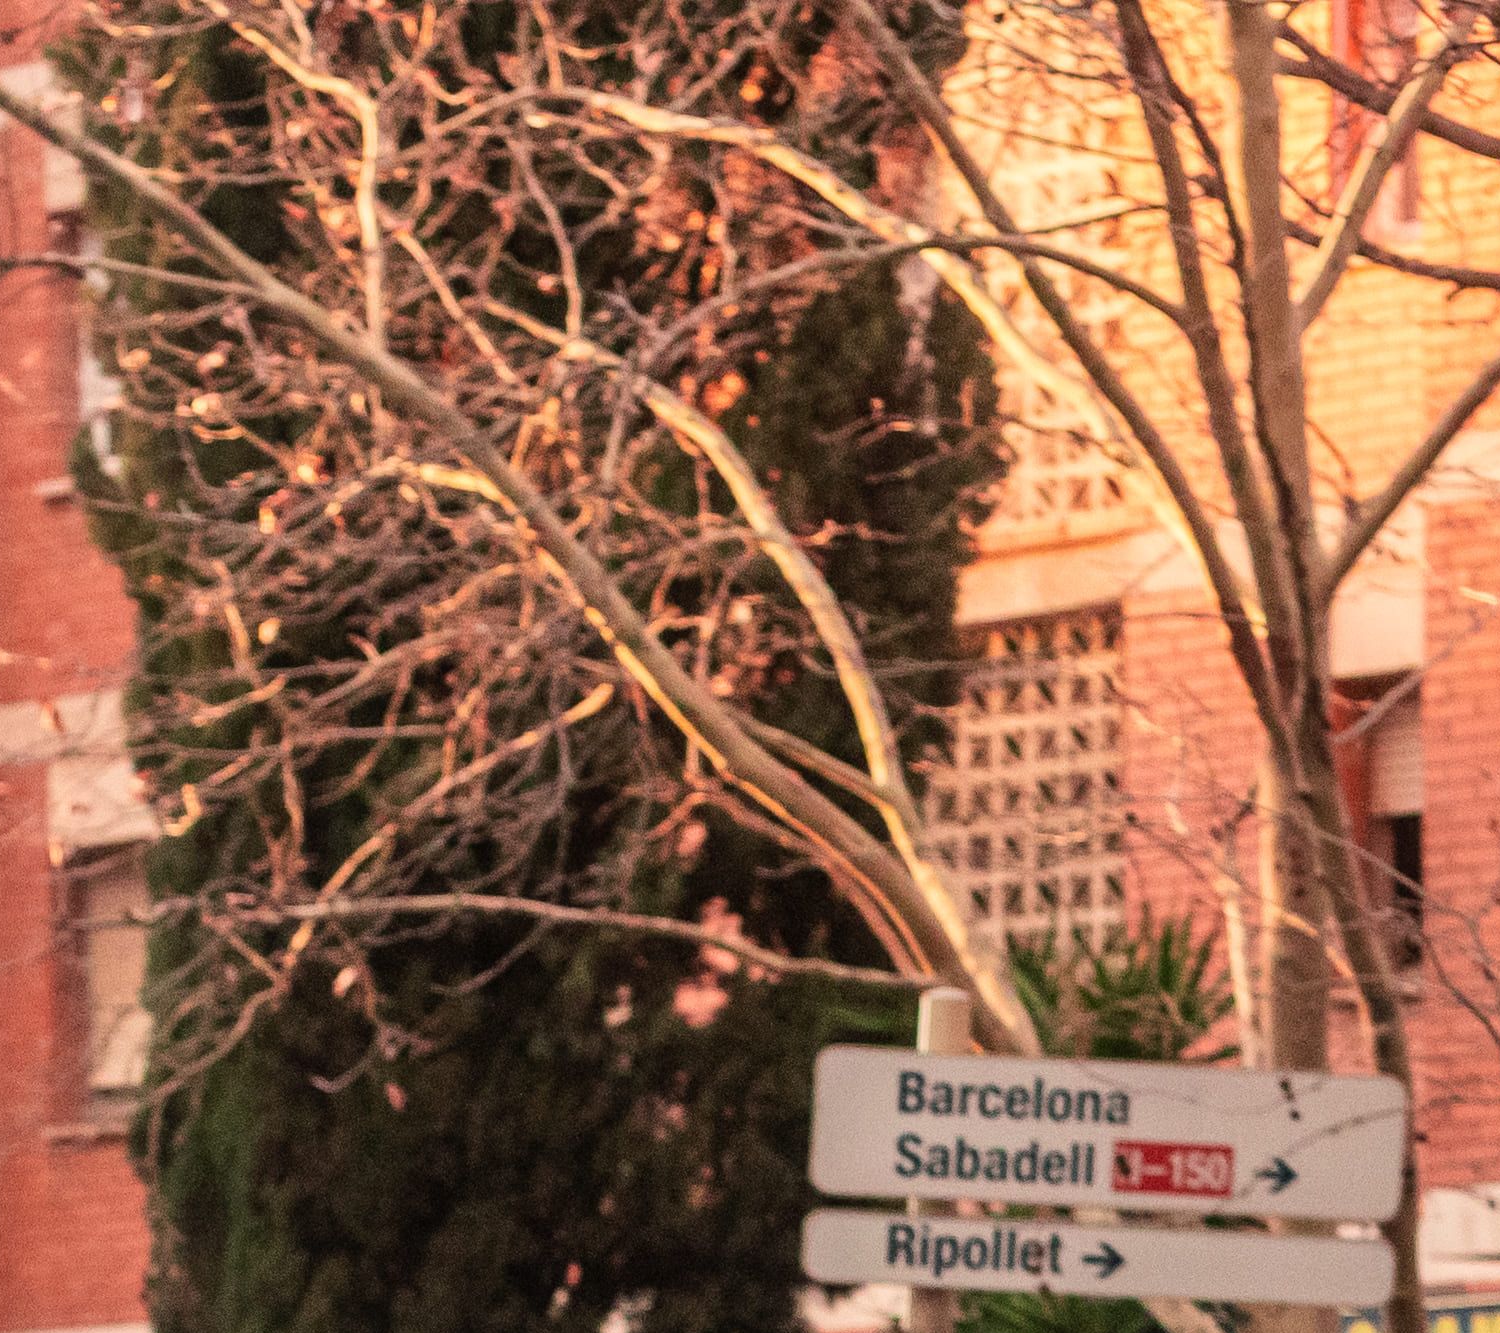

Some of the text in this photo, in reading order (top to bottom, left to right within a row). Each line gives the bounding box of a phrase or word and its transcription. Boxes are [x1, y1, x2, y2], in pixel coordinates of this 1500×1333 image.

[897, 1070, 1130, 1125] Barcelona
[895, 1131, 1095, 1185] Sabadell
[886, 1222, 1063, 1278] Ripollet
